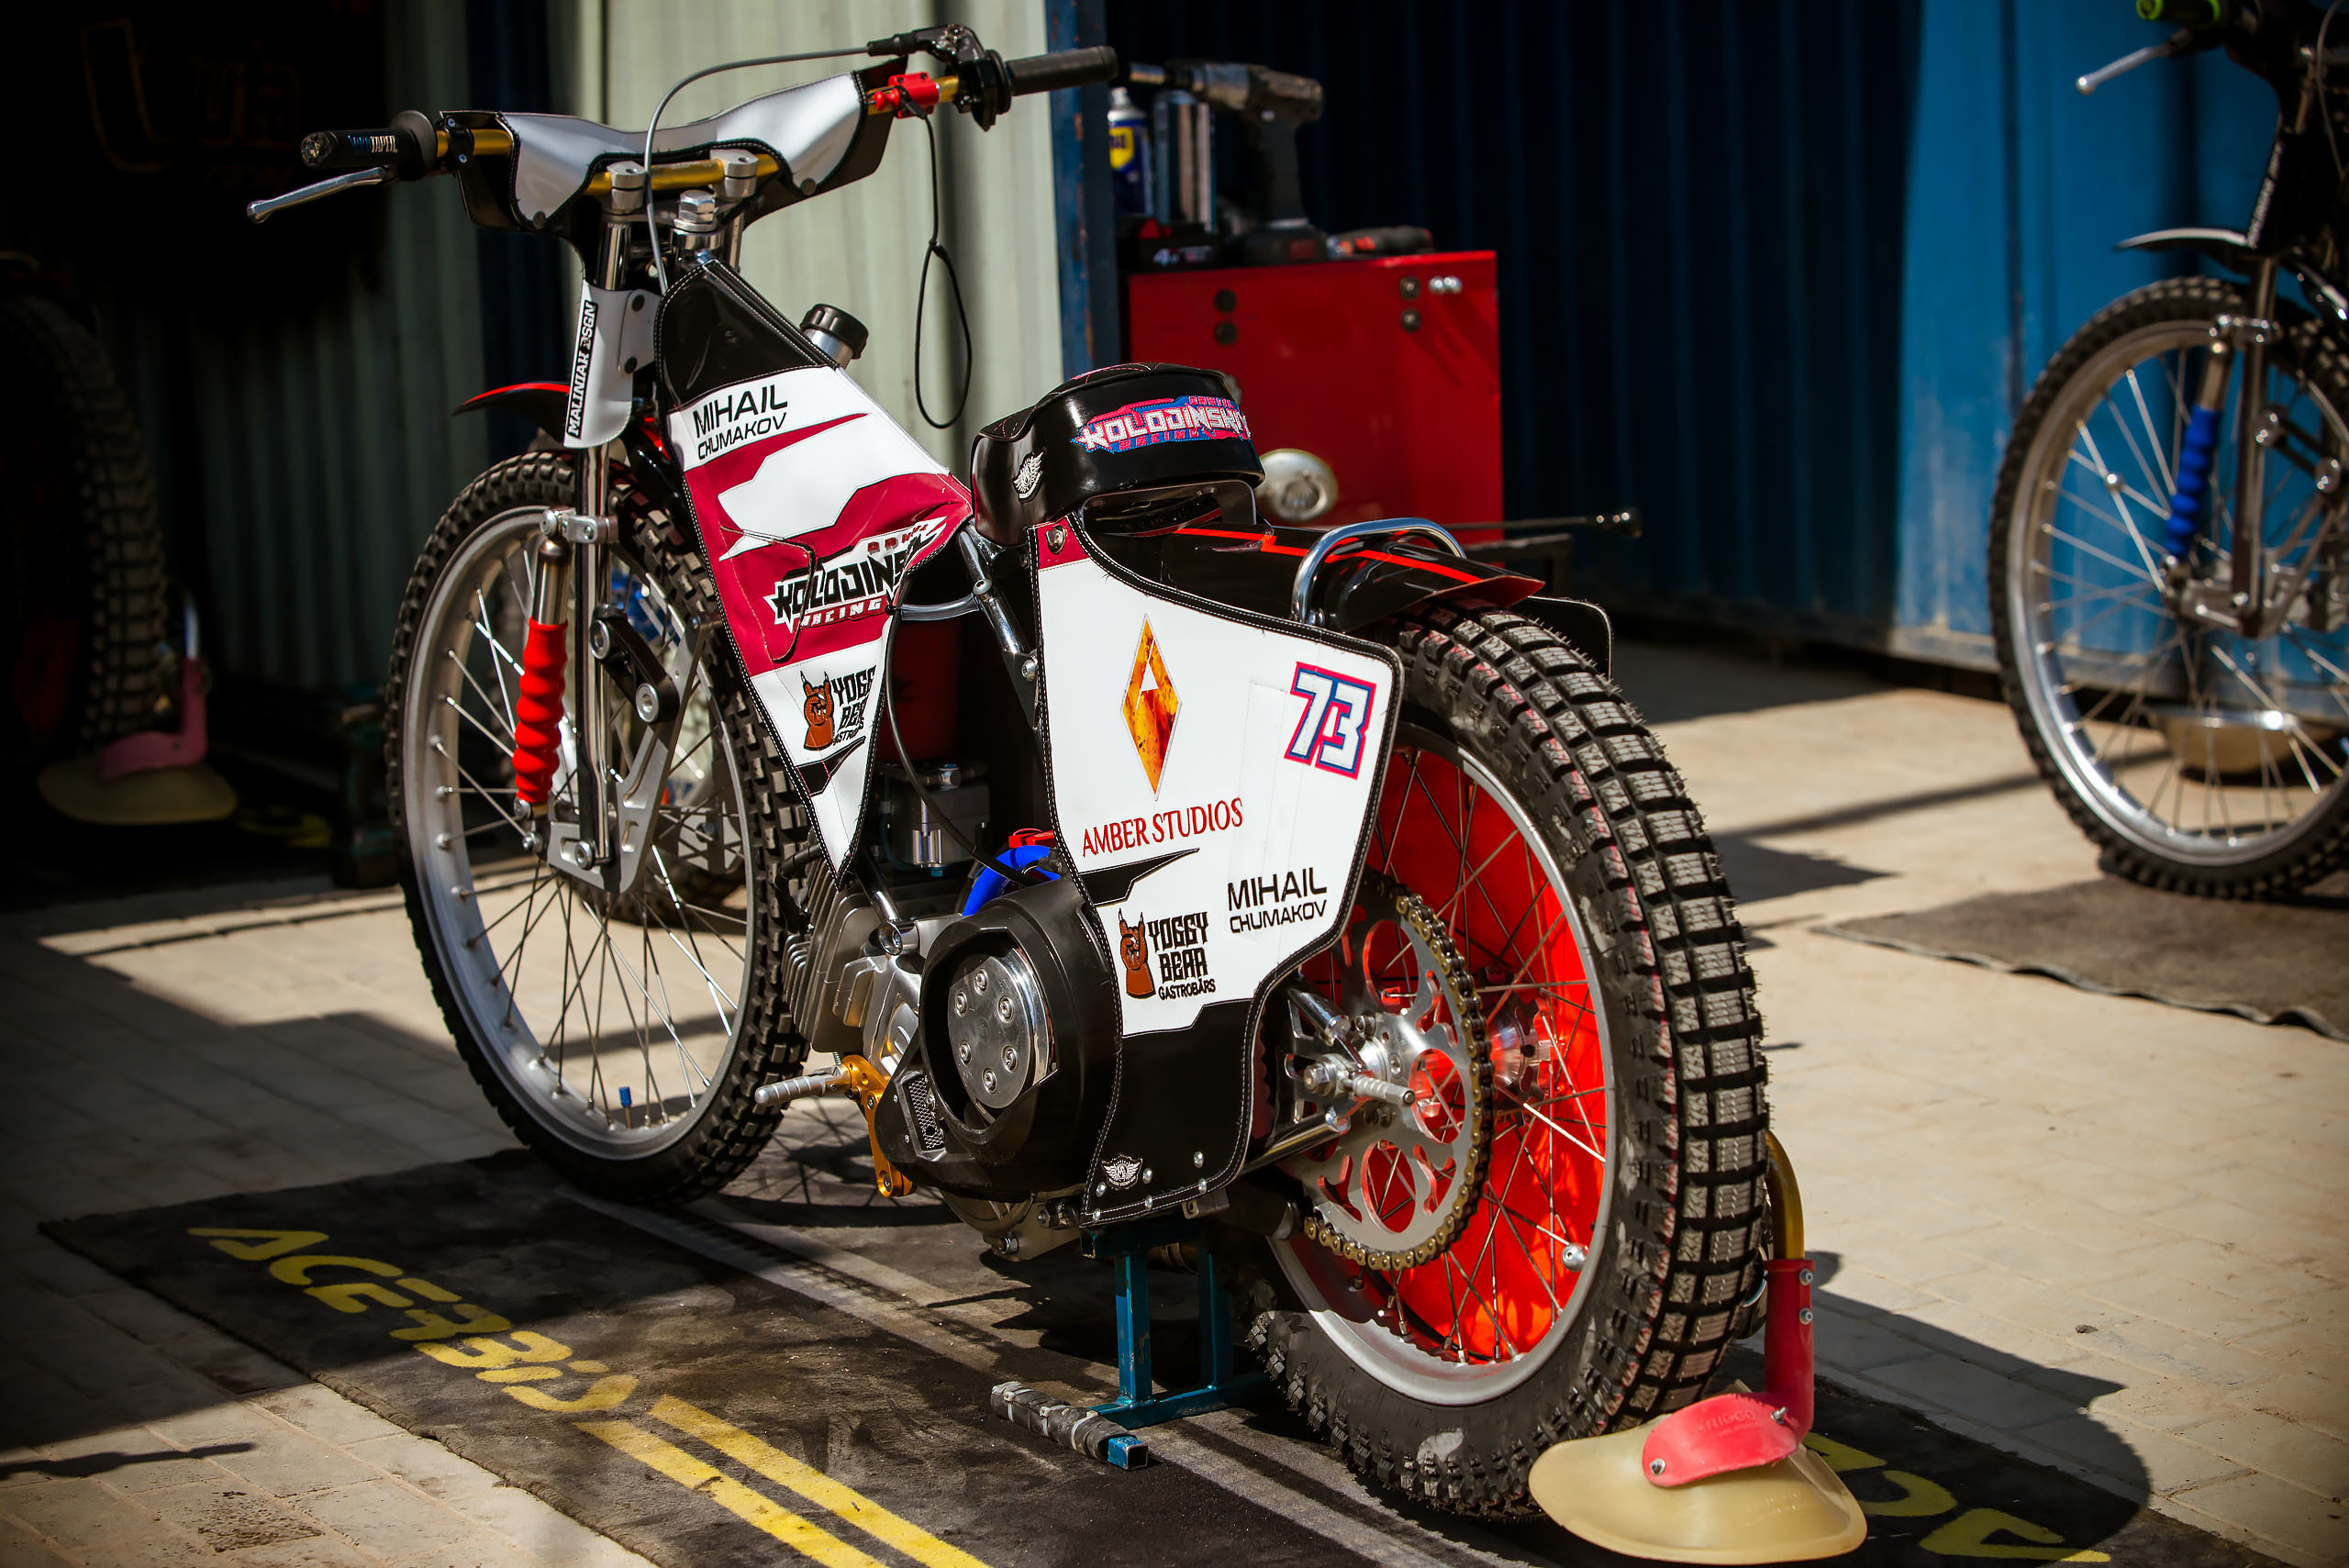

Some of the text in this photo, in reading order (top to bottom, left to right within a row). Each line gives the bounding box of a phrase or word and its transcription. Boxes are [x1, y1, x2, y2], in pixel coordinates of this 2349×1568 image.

[568, 350, 590, 438] MALINIAK
[693, 384, 788, 439] MIHAIL
[698, 412, 787, 460] CHUMAKOV
[1119, 428, 1199, 451] RACING
[1285, 662, 1376, 780] 73
[1083, 797, 1243, 858] AMBER STUDIOS
[1228, 867, 1327, 911] MIHAIL
[1146, 911, 1209, 953] YOGGY
[1230, 899, 1327, 934] CHUMAKOV
